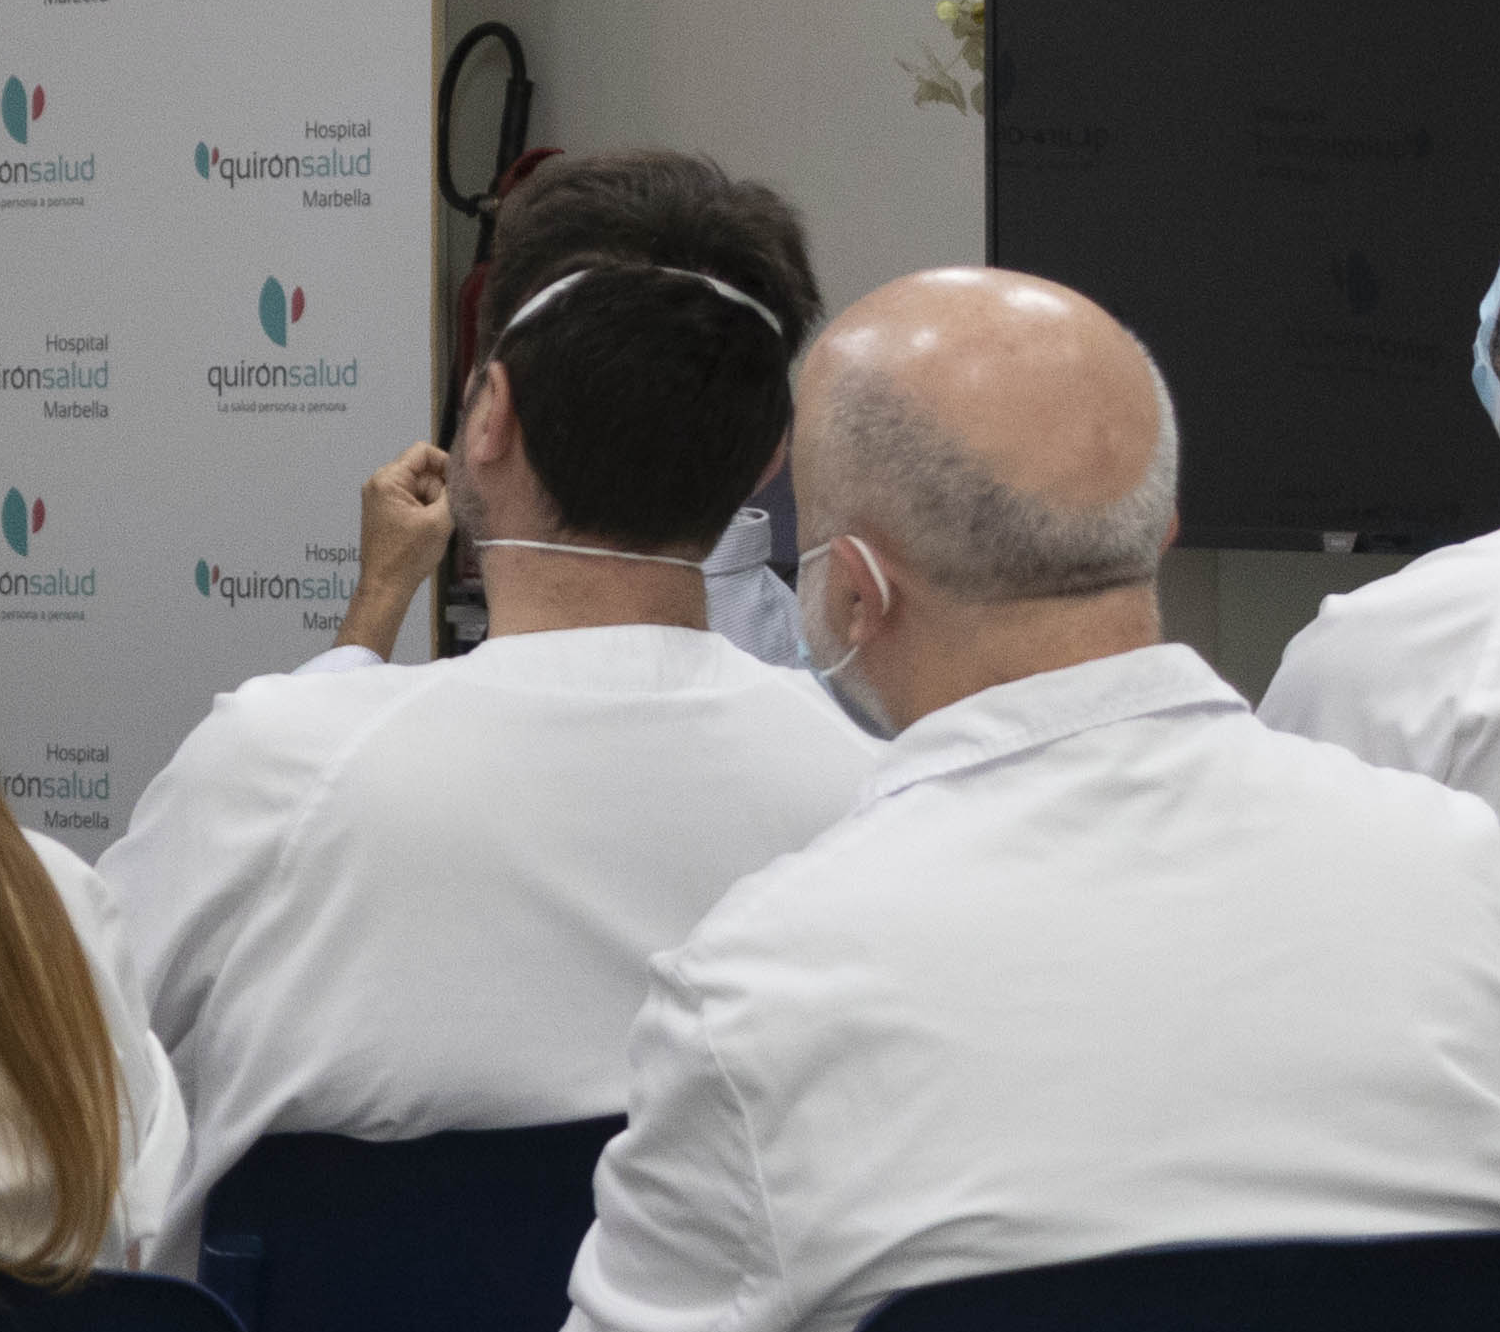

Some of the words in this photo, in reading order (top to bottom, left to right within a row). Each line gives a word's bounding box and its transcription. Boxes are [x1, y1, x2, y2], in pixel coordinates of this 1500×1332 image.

[304, 120, 371, 142] Hospital
[302, 188, 371, 209] Marbella
[44, 334, 108, 355] Hospital
[42, 400, 108, 420] Marbella
[45, 743, 109, 765] Hospital
[43, 811, 109, 830] Marbella
